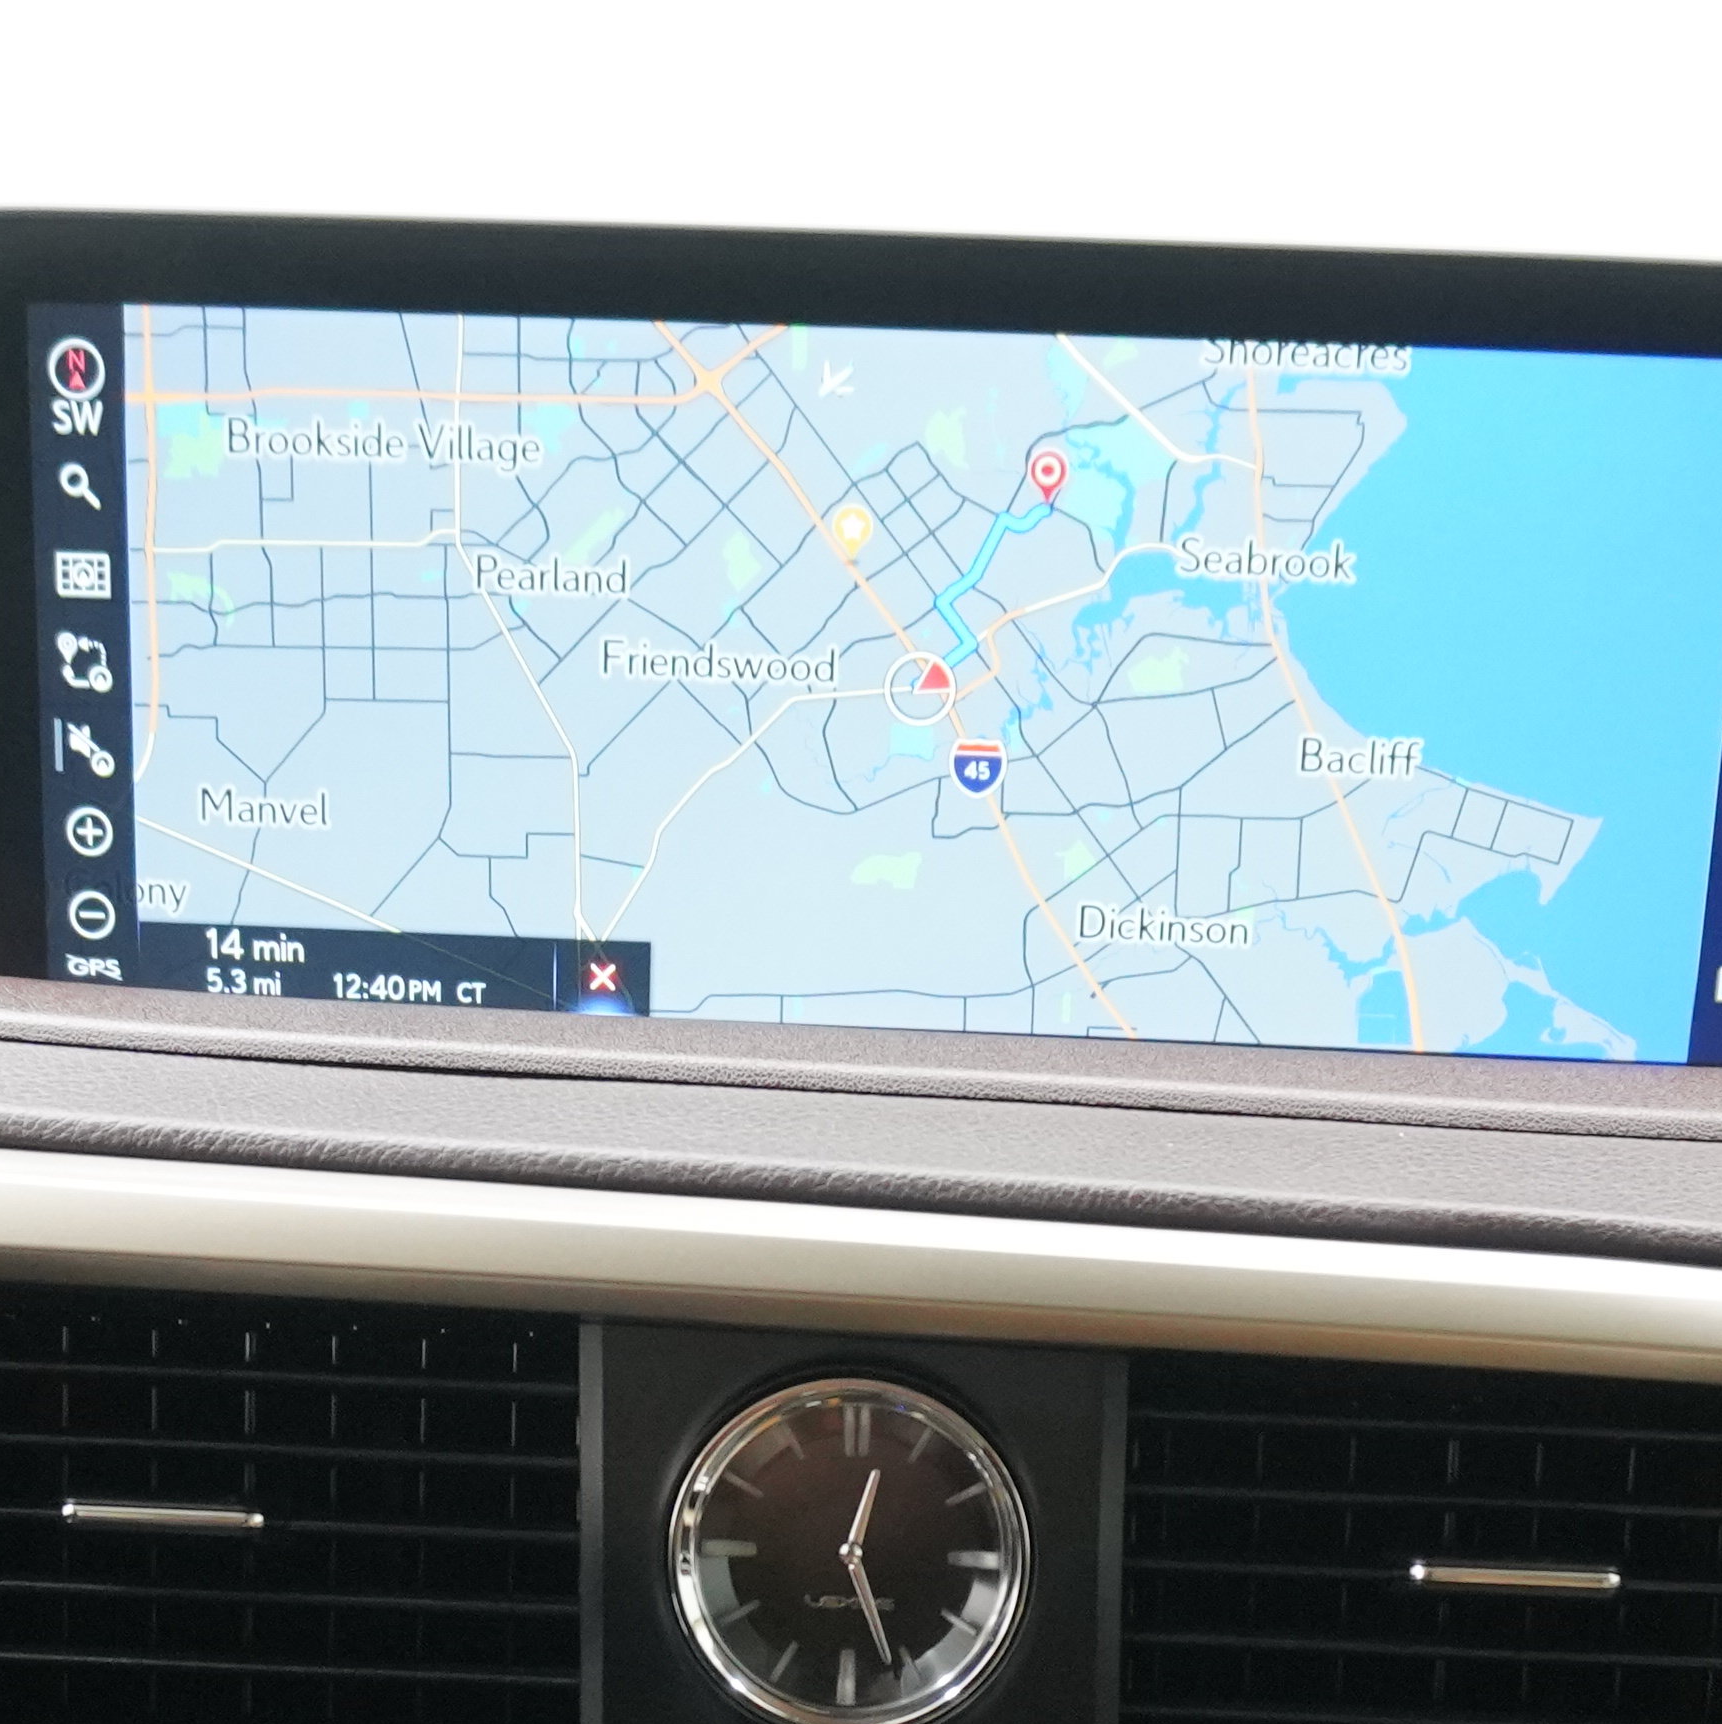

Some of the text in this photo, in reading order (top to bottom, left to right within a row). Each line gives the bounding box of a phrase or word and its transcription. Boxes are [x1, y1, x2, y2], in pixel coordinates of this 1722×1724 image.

[51, 398, 104, 437] SW
[226, 416, 541, 472] Brookside Village
[476, 553, 628, 594] Pearland
[1180, 536, 1352, 580] Seabrook
[602, 639, 836, 683] Friendswood
[963, 760, 991, 781] 45
[1300, 736, 1420, 776] Bacliff
[201, 787, 328, 826] Manvel
[1079, 904, 1249, 945] Dickinson
[205, 926, 306, 964] 14 min
[205, 966, 282, 997] 5.3 mi
[455, 981, 488, 1005] CT
